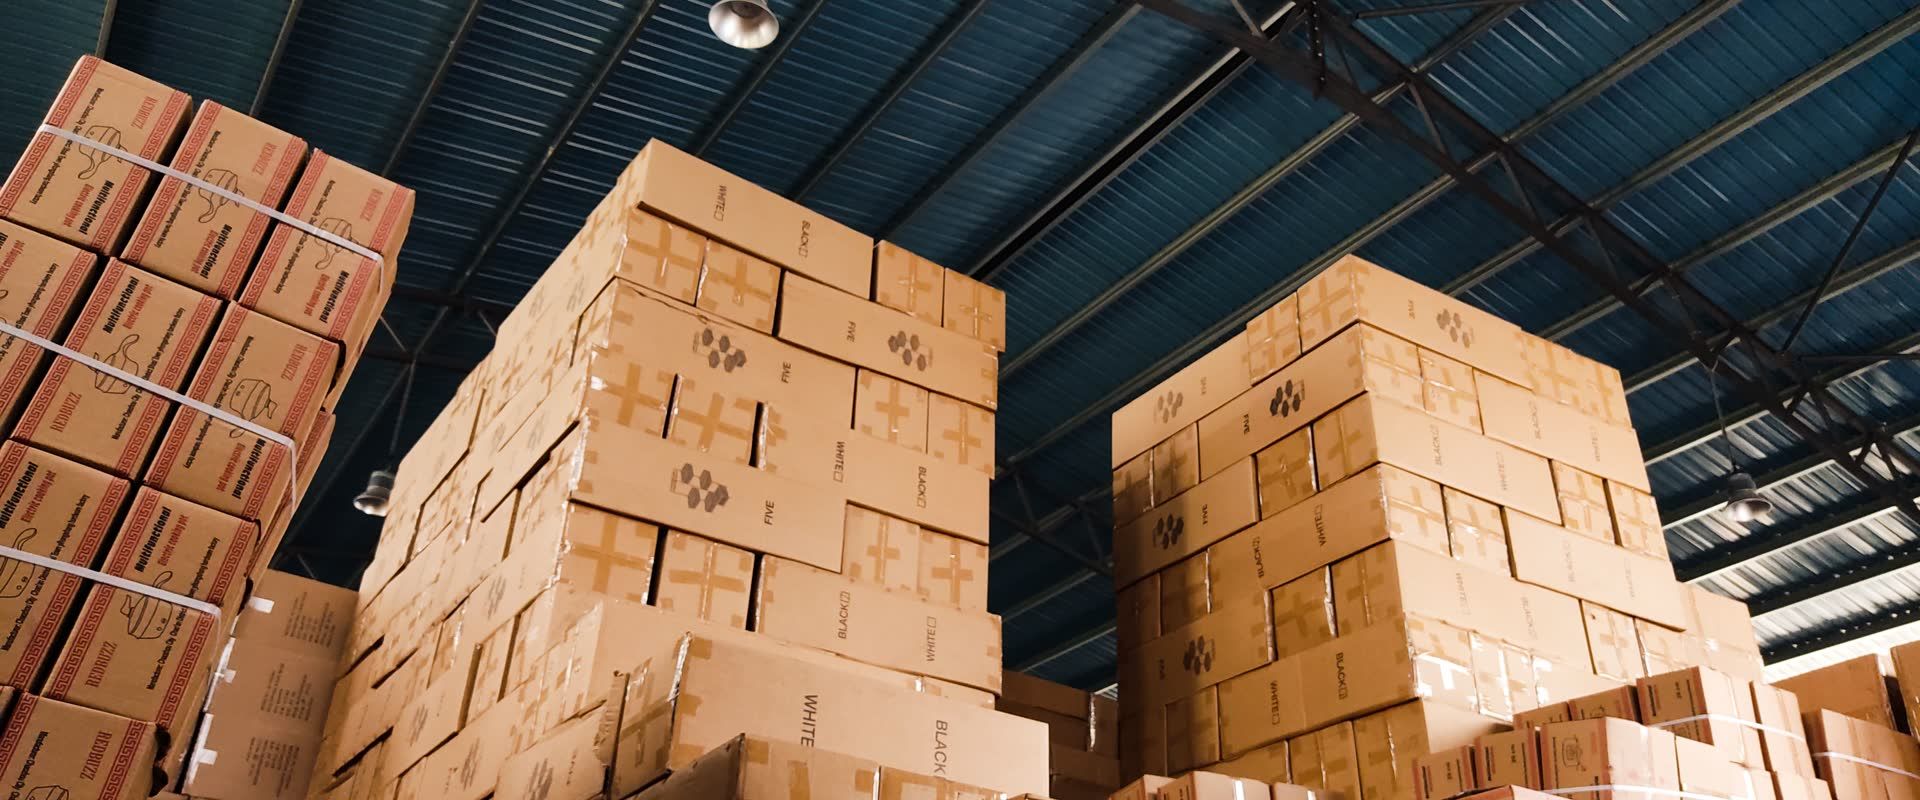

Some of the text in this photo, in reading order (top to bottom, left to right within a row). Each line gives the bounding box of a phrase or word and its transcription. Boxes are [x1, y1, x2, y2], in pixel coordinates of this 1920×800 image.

[78, 180, 114, 235] Multifunctional
[716, 186, 726, 212] WHITE
[801, 220, 810, 247] BLACK
[3, 247, 21, 267] cooking
[14, 240, 24, 251] pot
[200, 224, 232, 279] Multifunctional
[103, 276, 139, 334] Multifunctional
[134, 293, 150, 311] cooking
[143, 284, 152, 294] pot
[319, 271, 349, 323] Multifunctional
[847, 321, 856, 342] FIVE
[281, 344, 307, 381] REDBUZZ
[782, 362, 791, 383] FIVE
[50, 392, 82, 433] REDBUZZ
[835, 442, 844, 470] WHITE
[1432, 435, 1442, 466] BLACK
[232, 438, 266, 499] Multifunctional
[918, 466, 926, 496] BLACK
[20, 470, 56, 523] Electric cooking pot
[764, 501, 774, 525] FIVE
[134, 506, 171, 572] Multifunctional
[158, 515, 188, 566] Electric cooking pot
[1315, 516, 1326, 546] WHITE
[1254, 547, 1264, 578] BLACK
[838, 604, 848, 639] BLACK
[926, 630, 935, 661] WHITE
[85, 641, 117, 687] REDBUZZ
[1336, 652, 1346, 687] BLACK
[1270, 680, 1280, 712] WHITE
[801, 694, 818, 748] WHITE
[80, 731, 112, 780] REDBUZZ
[934, 720, 948, 773] BLACK
